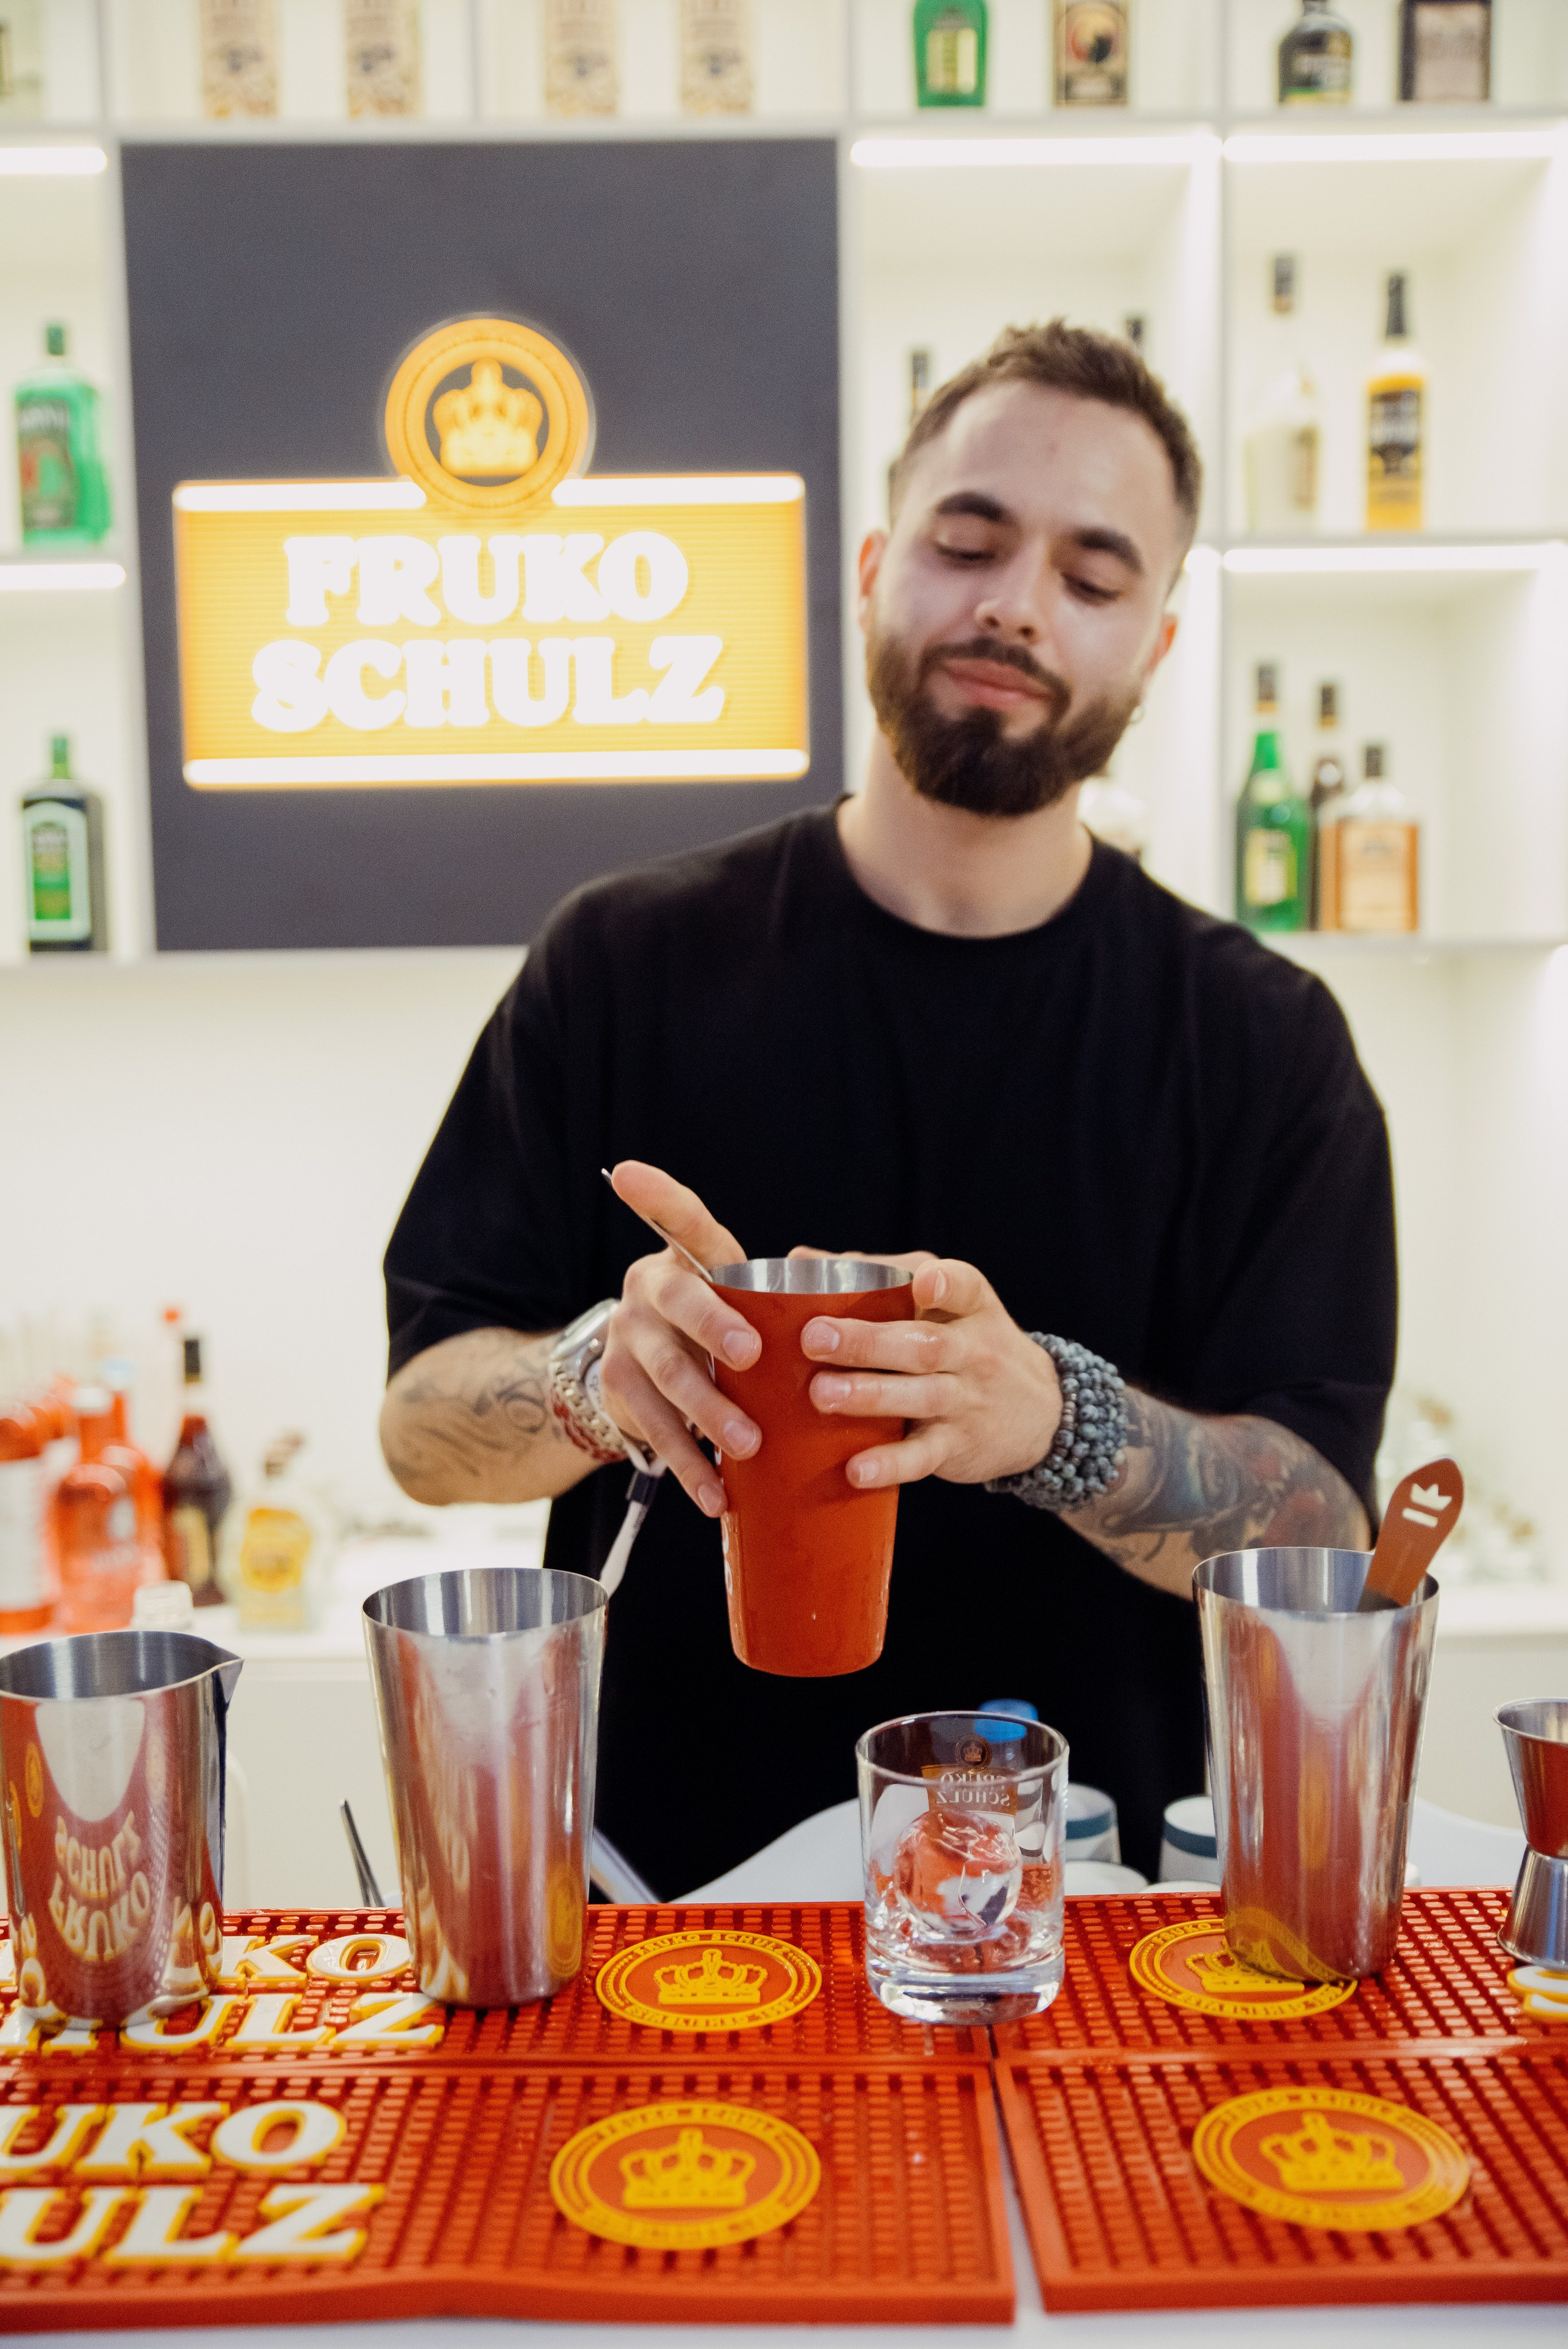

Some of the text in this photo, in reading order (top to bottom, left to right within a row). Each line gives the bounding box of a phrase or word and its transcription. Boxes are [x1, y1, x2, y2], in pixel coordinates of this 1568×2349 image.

[283, 530, 689, 626] FRUKO
[251, 635, 725, 733] SCHULZ
[633, 1933, 701, 1956] FRUKO
[1152, 1923, 1212, 1944] FRUKO
